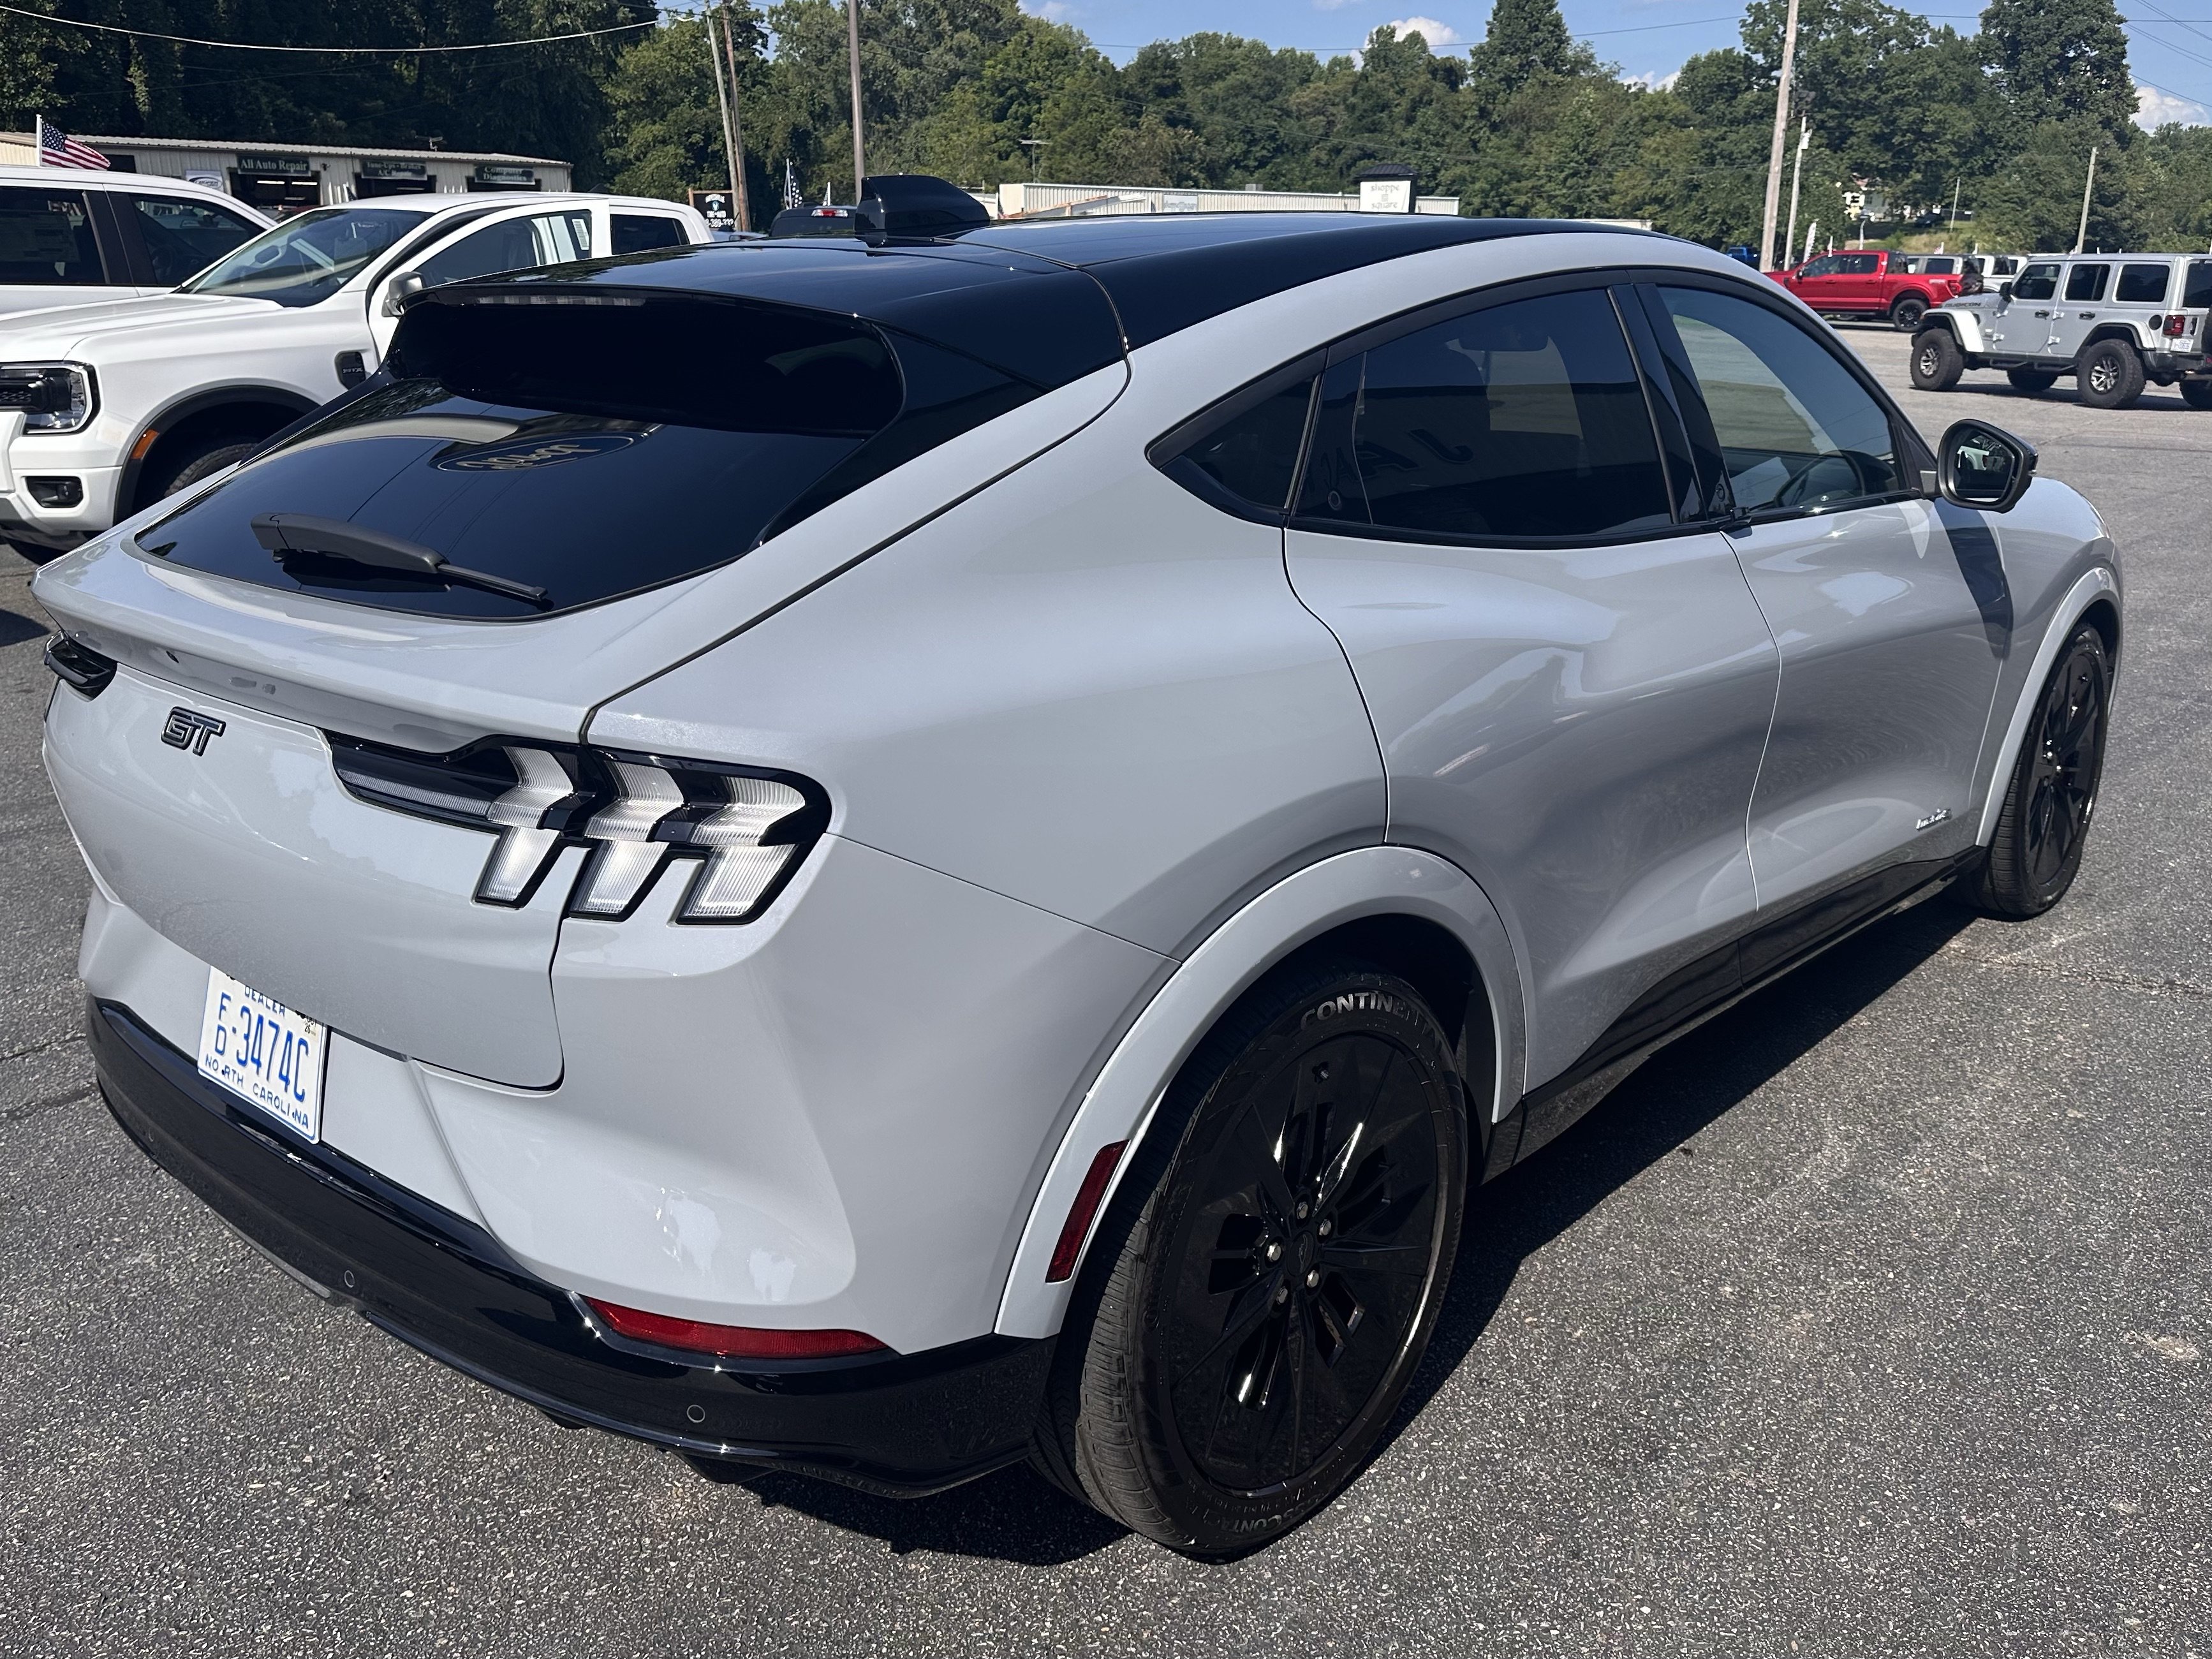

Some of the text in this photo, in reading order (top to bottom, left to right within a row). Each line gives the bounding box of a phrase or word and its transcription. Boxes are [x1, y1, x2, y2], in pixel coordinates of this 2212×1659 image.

[240, 159, 307, 173] All Auto Repair
[1371, 184, 1400, 193] shoppe
[1371, 202, 1397, 210] square
[161, 706, 226, 757] GT
[244, 985, 286, 1017] DEALER
[205, 1053, 309, 1129] NORTH CAROLINA
